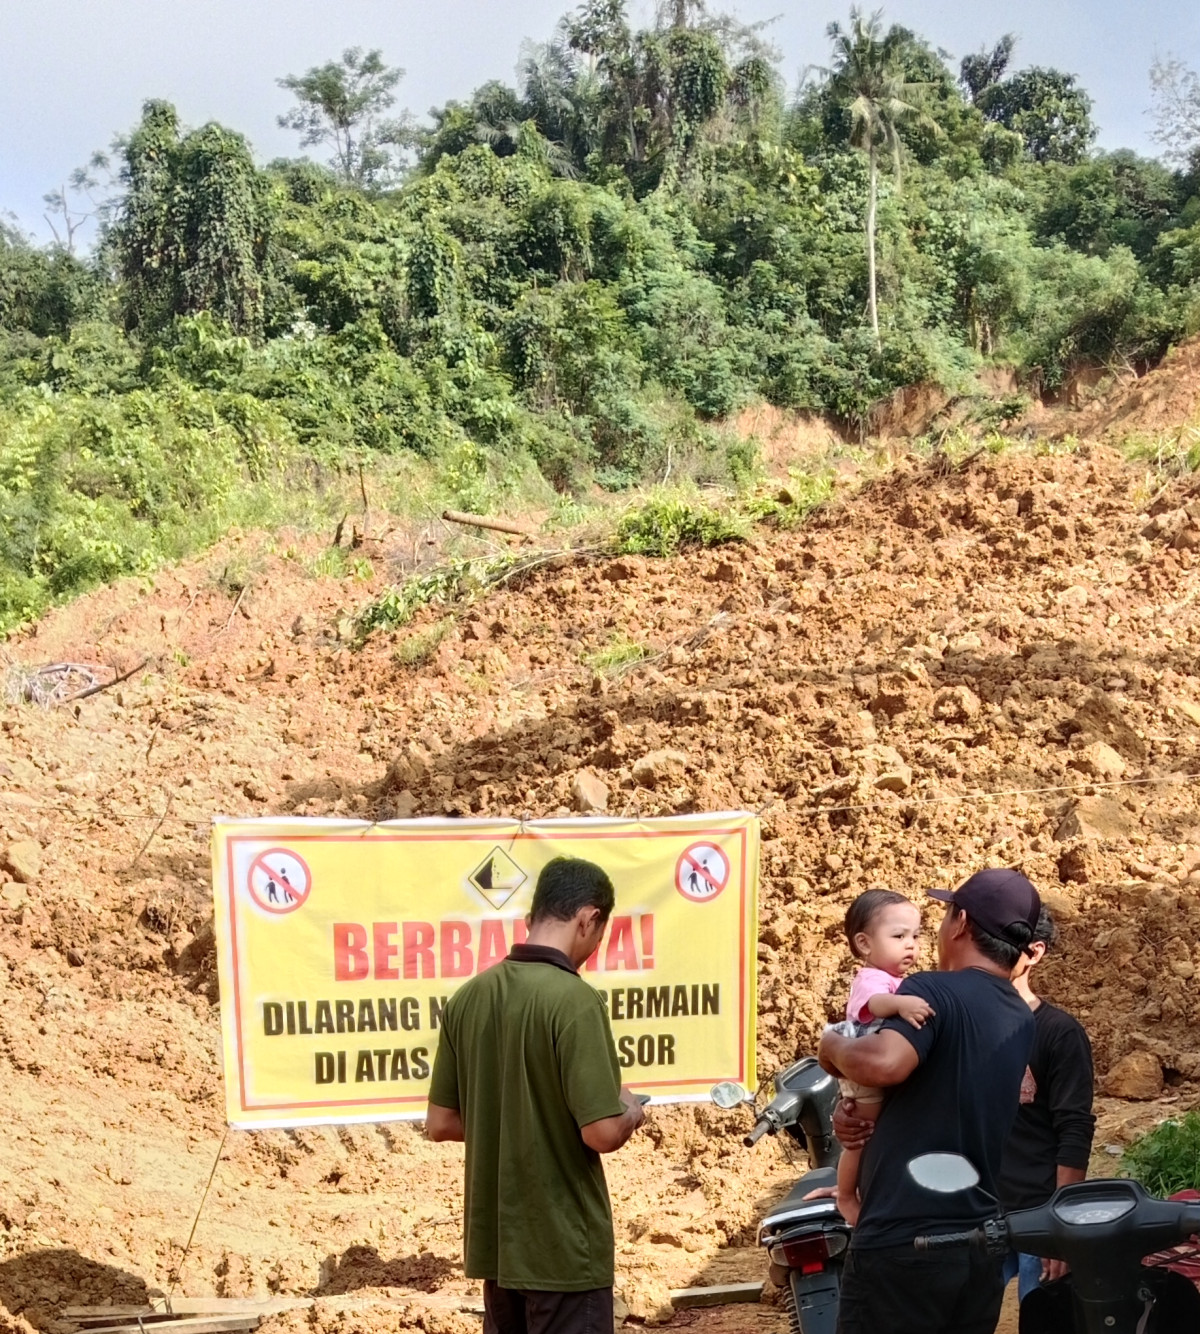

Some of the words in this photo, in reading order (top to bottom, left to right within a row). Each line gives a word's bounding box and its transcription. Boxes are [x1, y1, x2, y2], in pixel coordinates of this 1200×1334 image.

[333, 914, 655, 981] BERBAA!
[263, 996, 420, 1036] DILARANG
[314, 1051, 347, 1084] DI
[355, 1047, 430, 1082] ATAS
